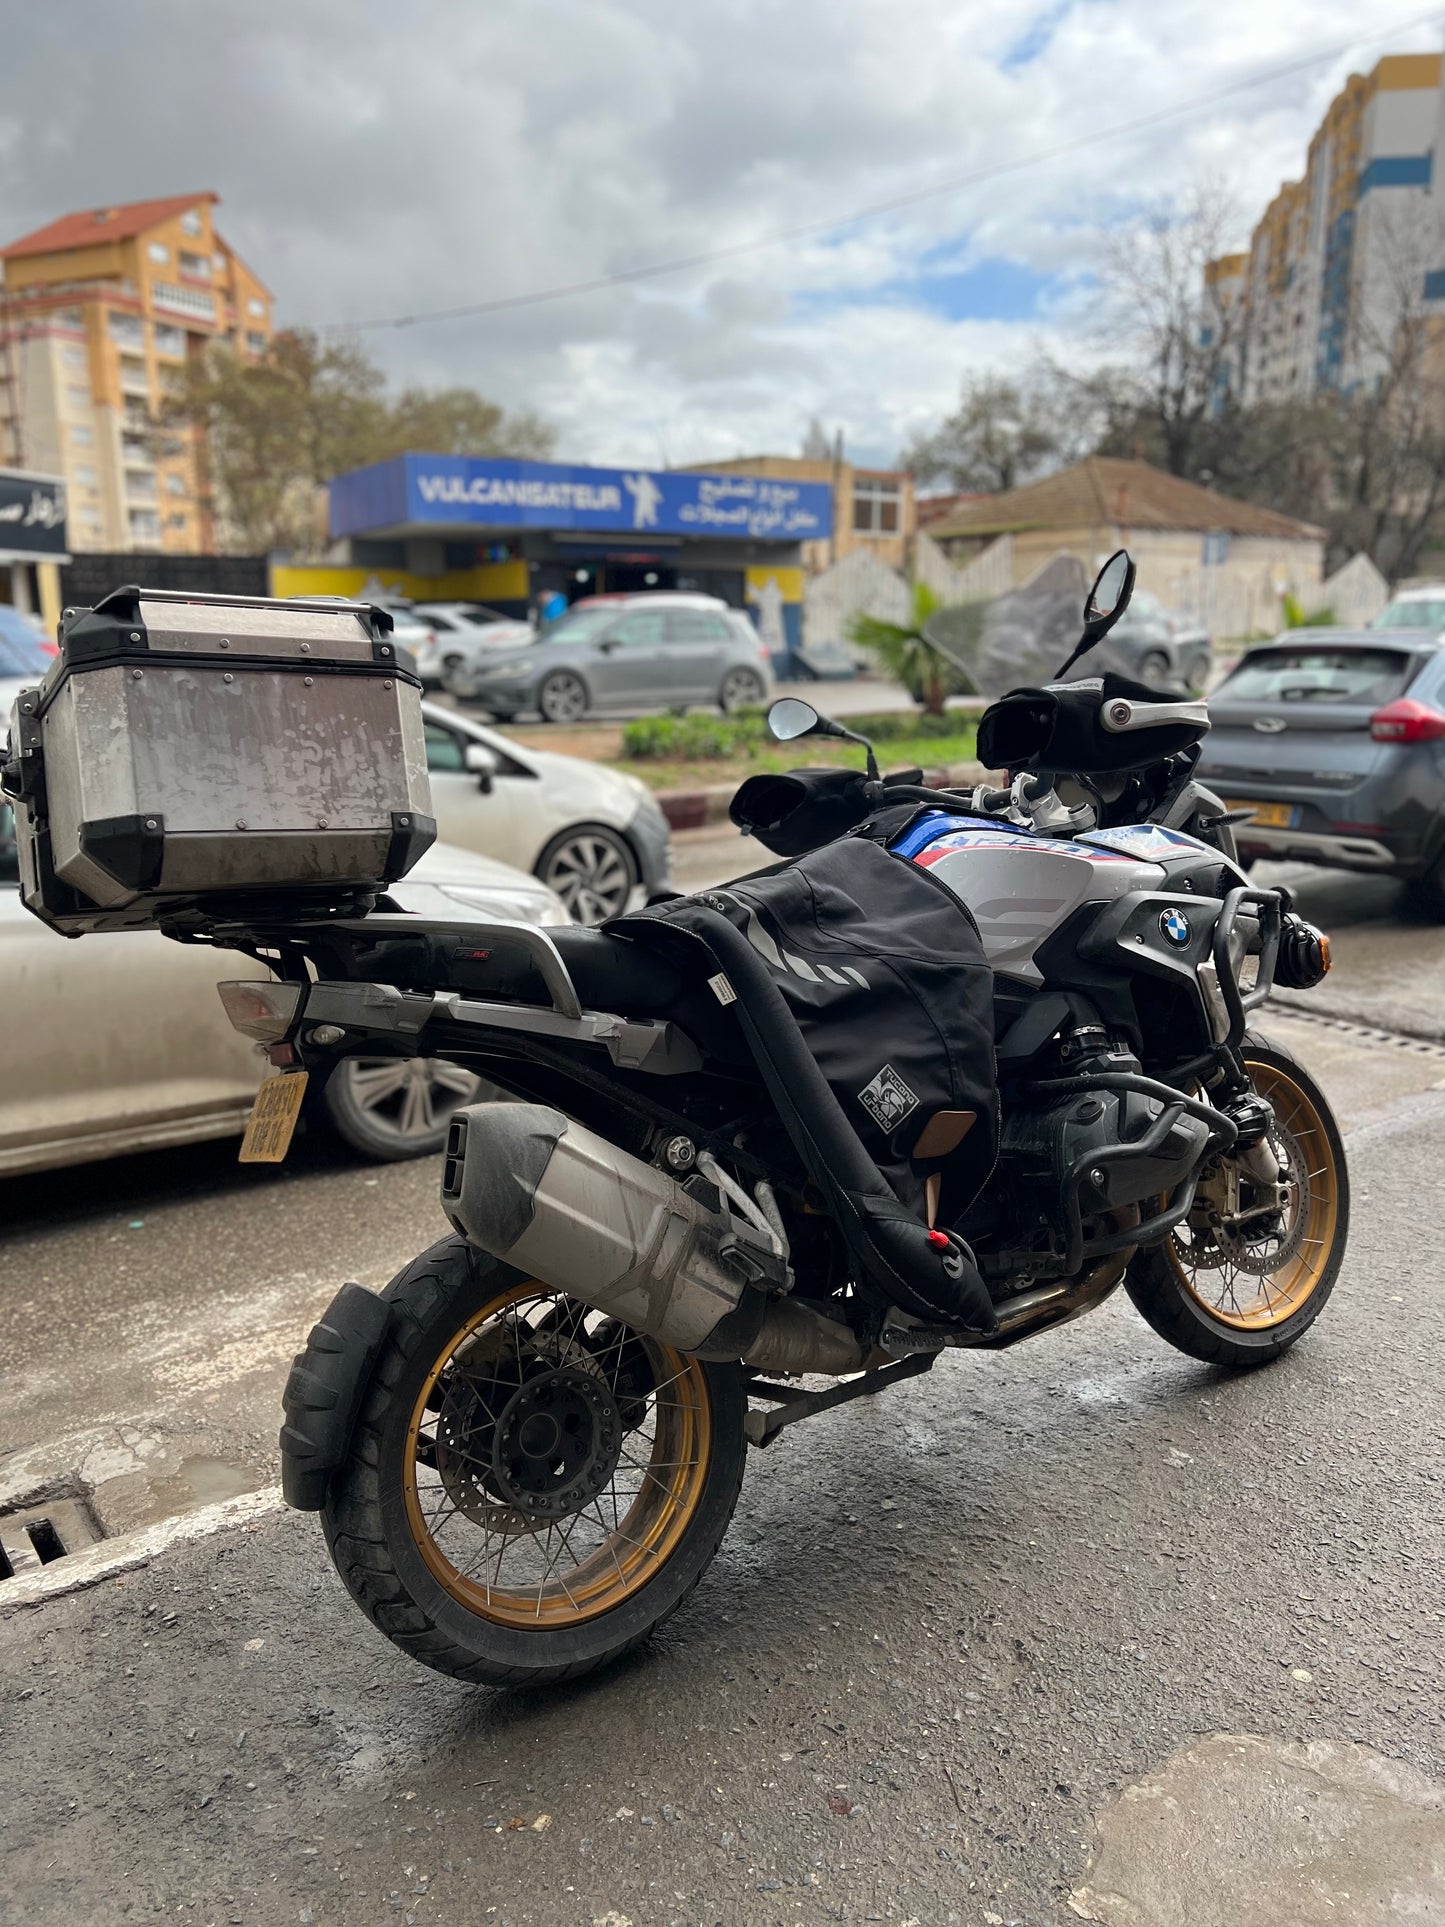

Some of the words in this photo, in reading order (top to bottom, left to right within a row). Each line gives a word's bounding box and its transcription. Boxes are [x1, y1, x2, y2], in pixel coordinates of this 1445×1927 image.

[417, 475, 621, 510] VULCANISATEUR
[709, 895, 725, 911] PRO
[1163, 910, 1189, 925] BMW
